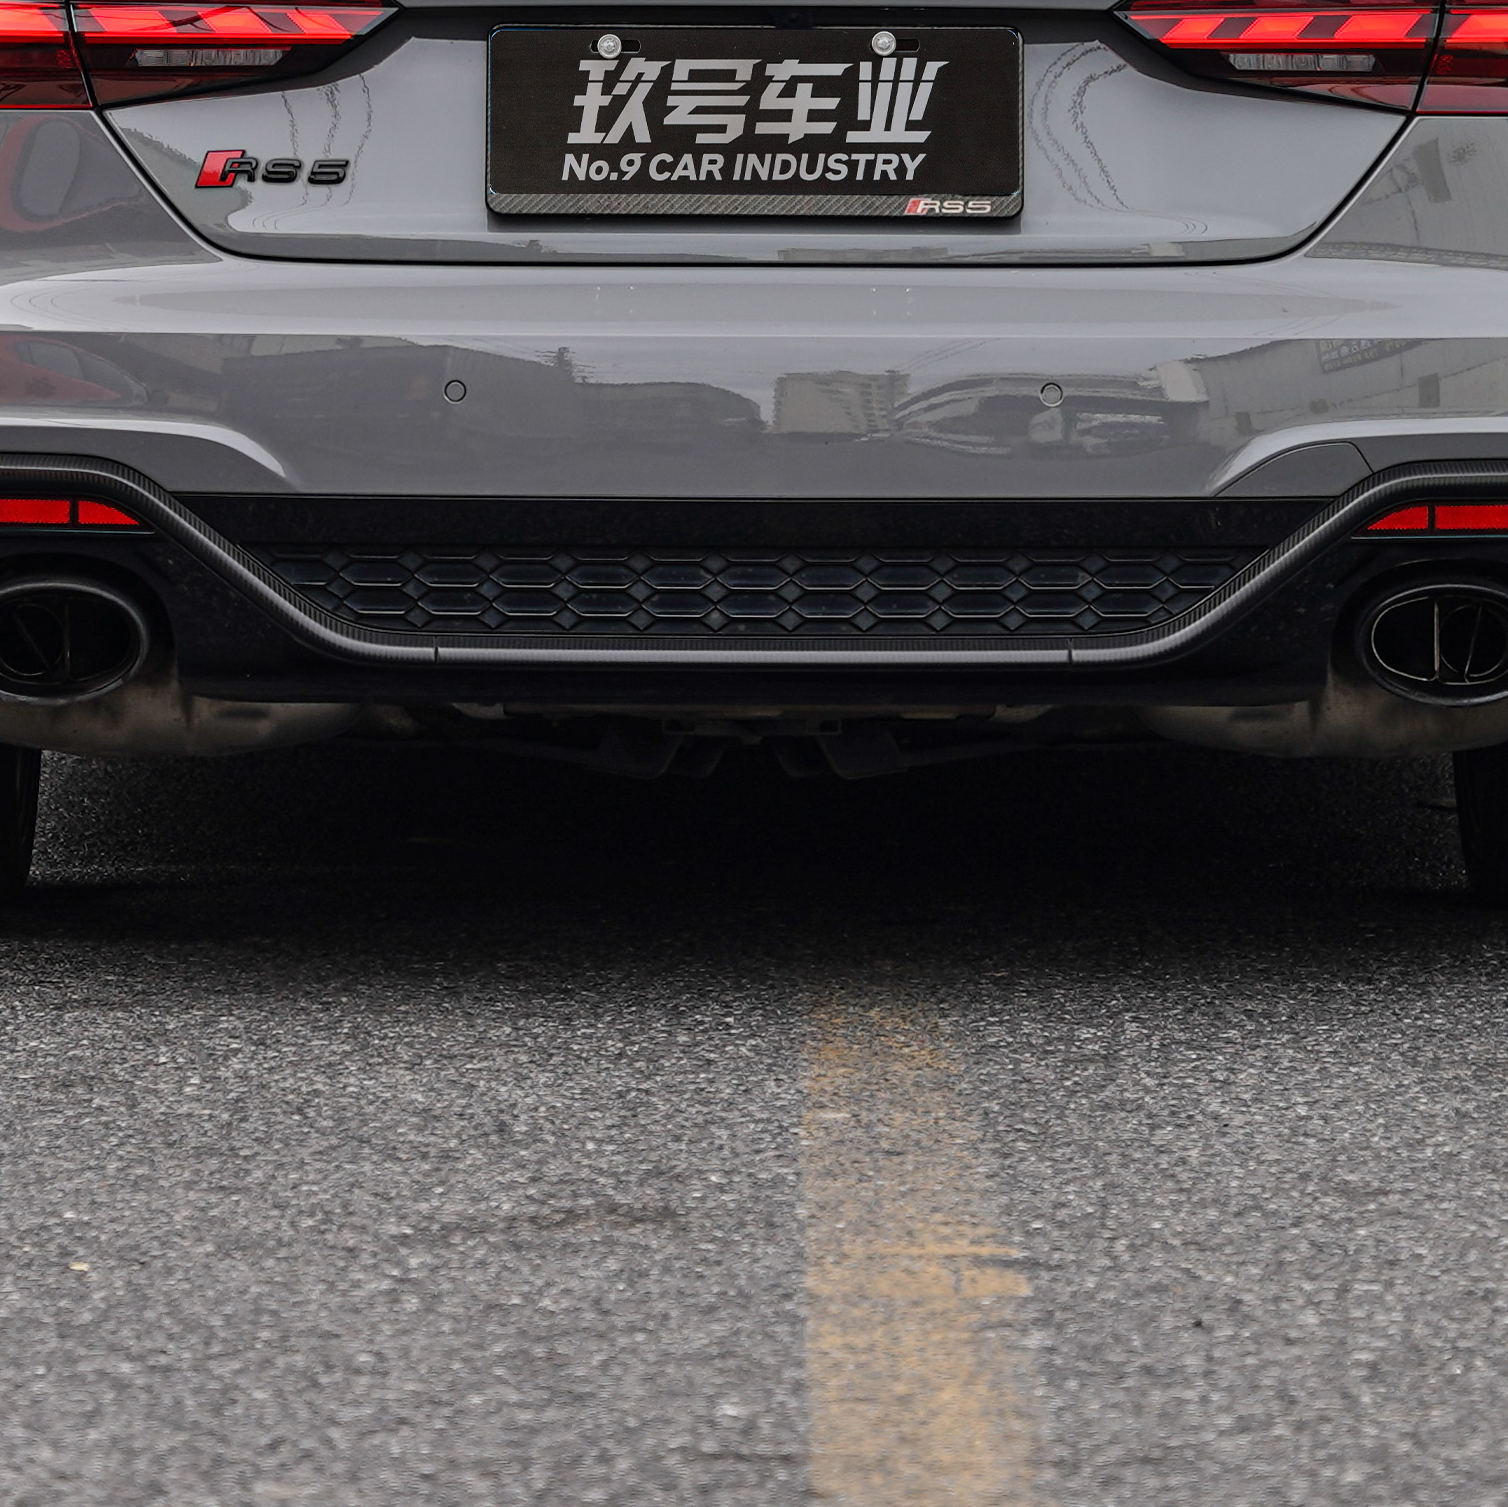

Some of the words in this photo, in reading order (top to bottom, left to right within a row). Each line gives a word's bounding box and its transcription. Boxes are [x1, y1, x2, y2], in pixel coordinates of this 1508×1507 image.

[566, 57, 950, 145] 玖号车业
[215, 154, 350, 187] RS5
[561, 152, 648, 183] No.9
[649, 152, 725, 183] CAR
[732, 152, 927, 183] INDUSTRY
[913, 198, 992, 215] RS5
